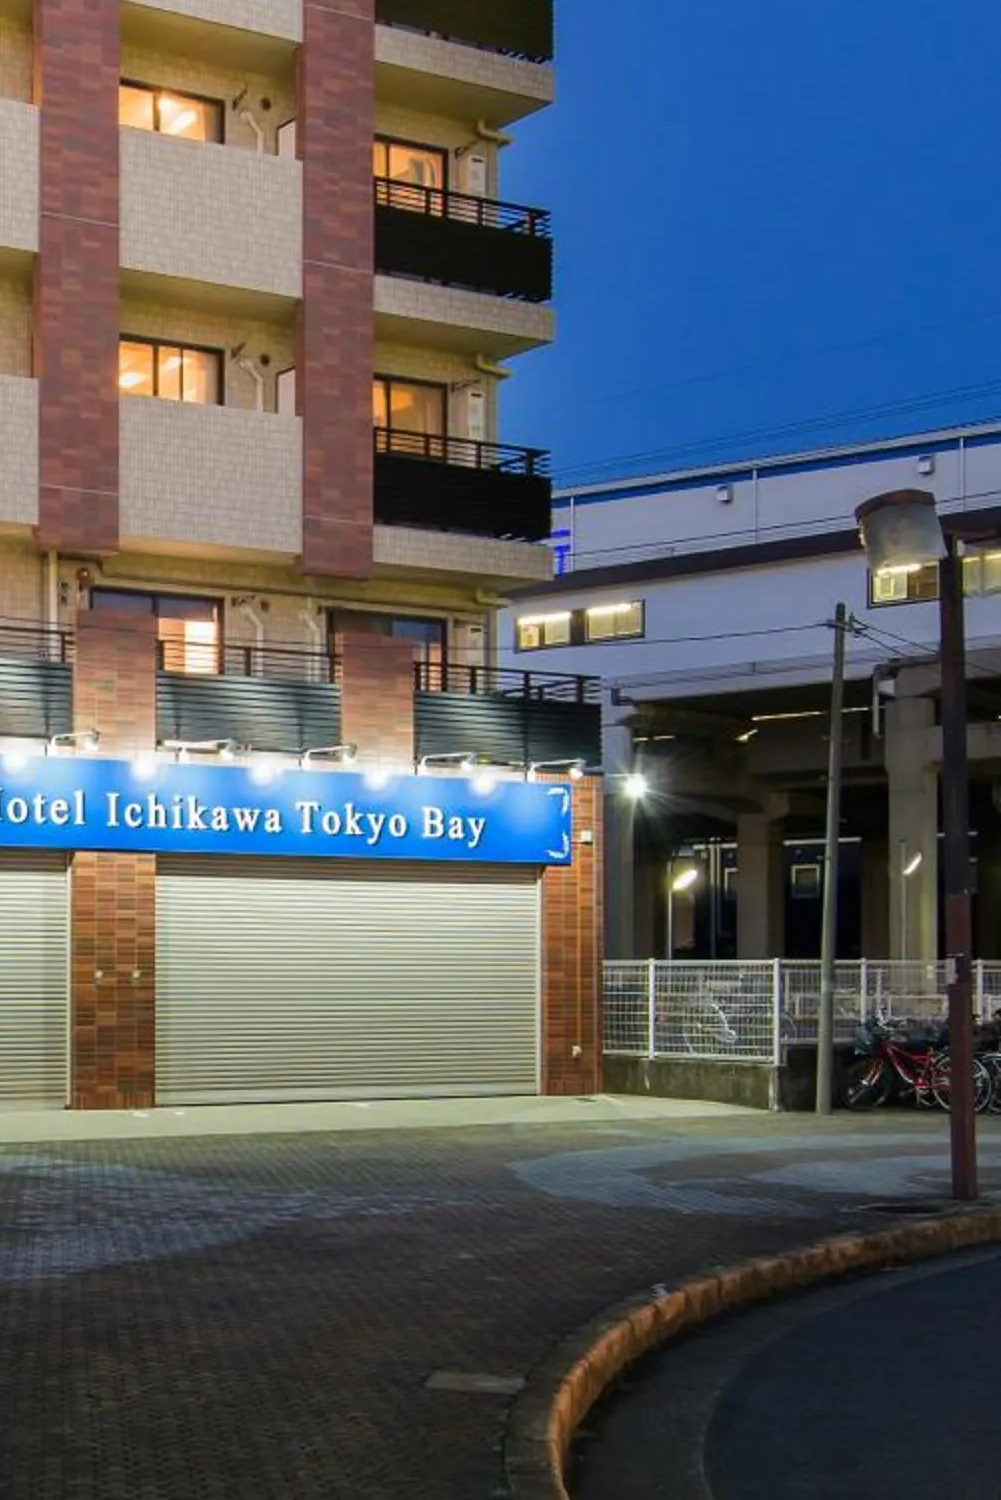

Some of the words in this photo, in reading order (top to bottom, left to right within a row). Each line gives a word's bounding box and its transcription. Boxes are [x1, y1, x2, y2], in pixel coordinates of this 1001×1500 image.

[106, 792, 283, 832] Ichikawa
[295, 802, 408, 845] Tokyo
[422, 806, 487, 848] Bay
